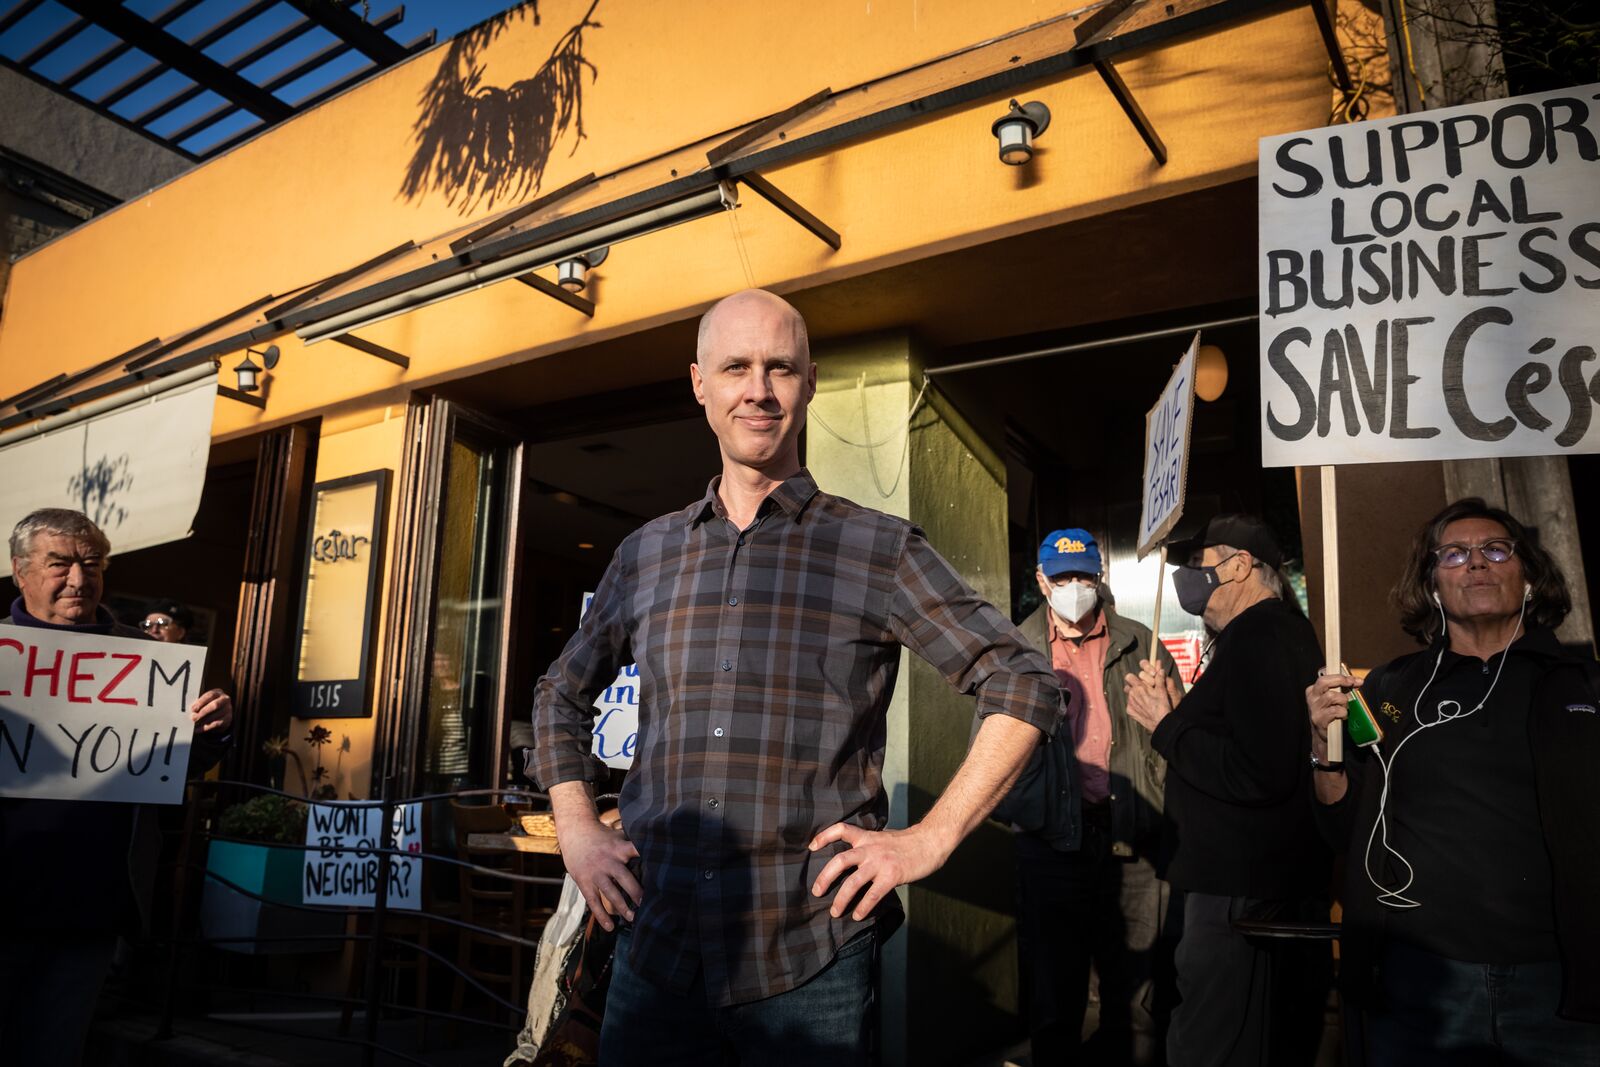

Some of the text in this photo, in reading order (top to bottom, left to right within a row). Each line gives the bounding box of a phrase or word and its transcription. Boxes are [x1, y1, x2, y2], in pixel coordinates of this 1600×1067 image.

[1272, 93, 1600, 199] SUPPOR
[1331, 175, 1563, 245] LOCAL
[1267, 316, 1441, 442] SAVE
[147, 659, 191, 712] M
[310, 684, 342, 707] 1515
[58, 722, 178, 783] YOU!
[390, 805, 416, 836] OU
[305, 860, 411, 899] NEIGHBR?
